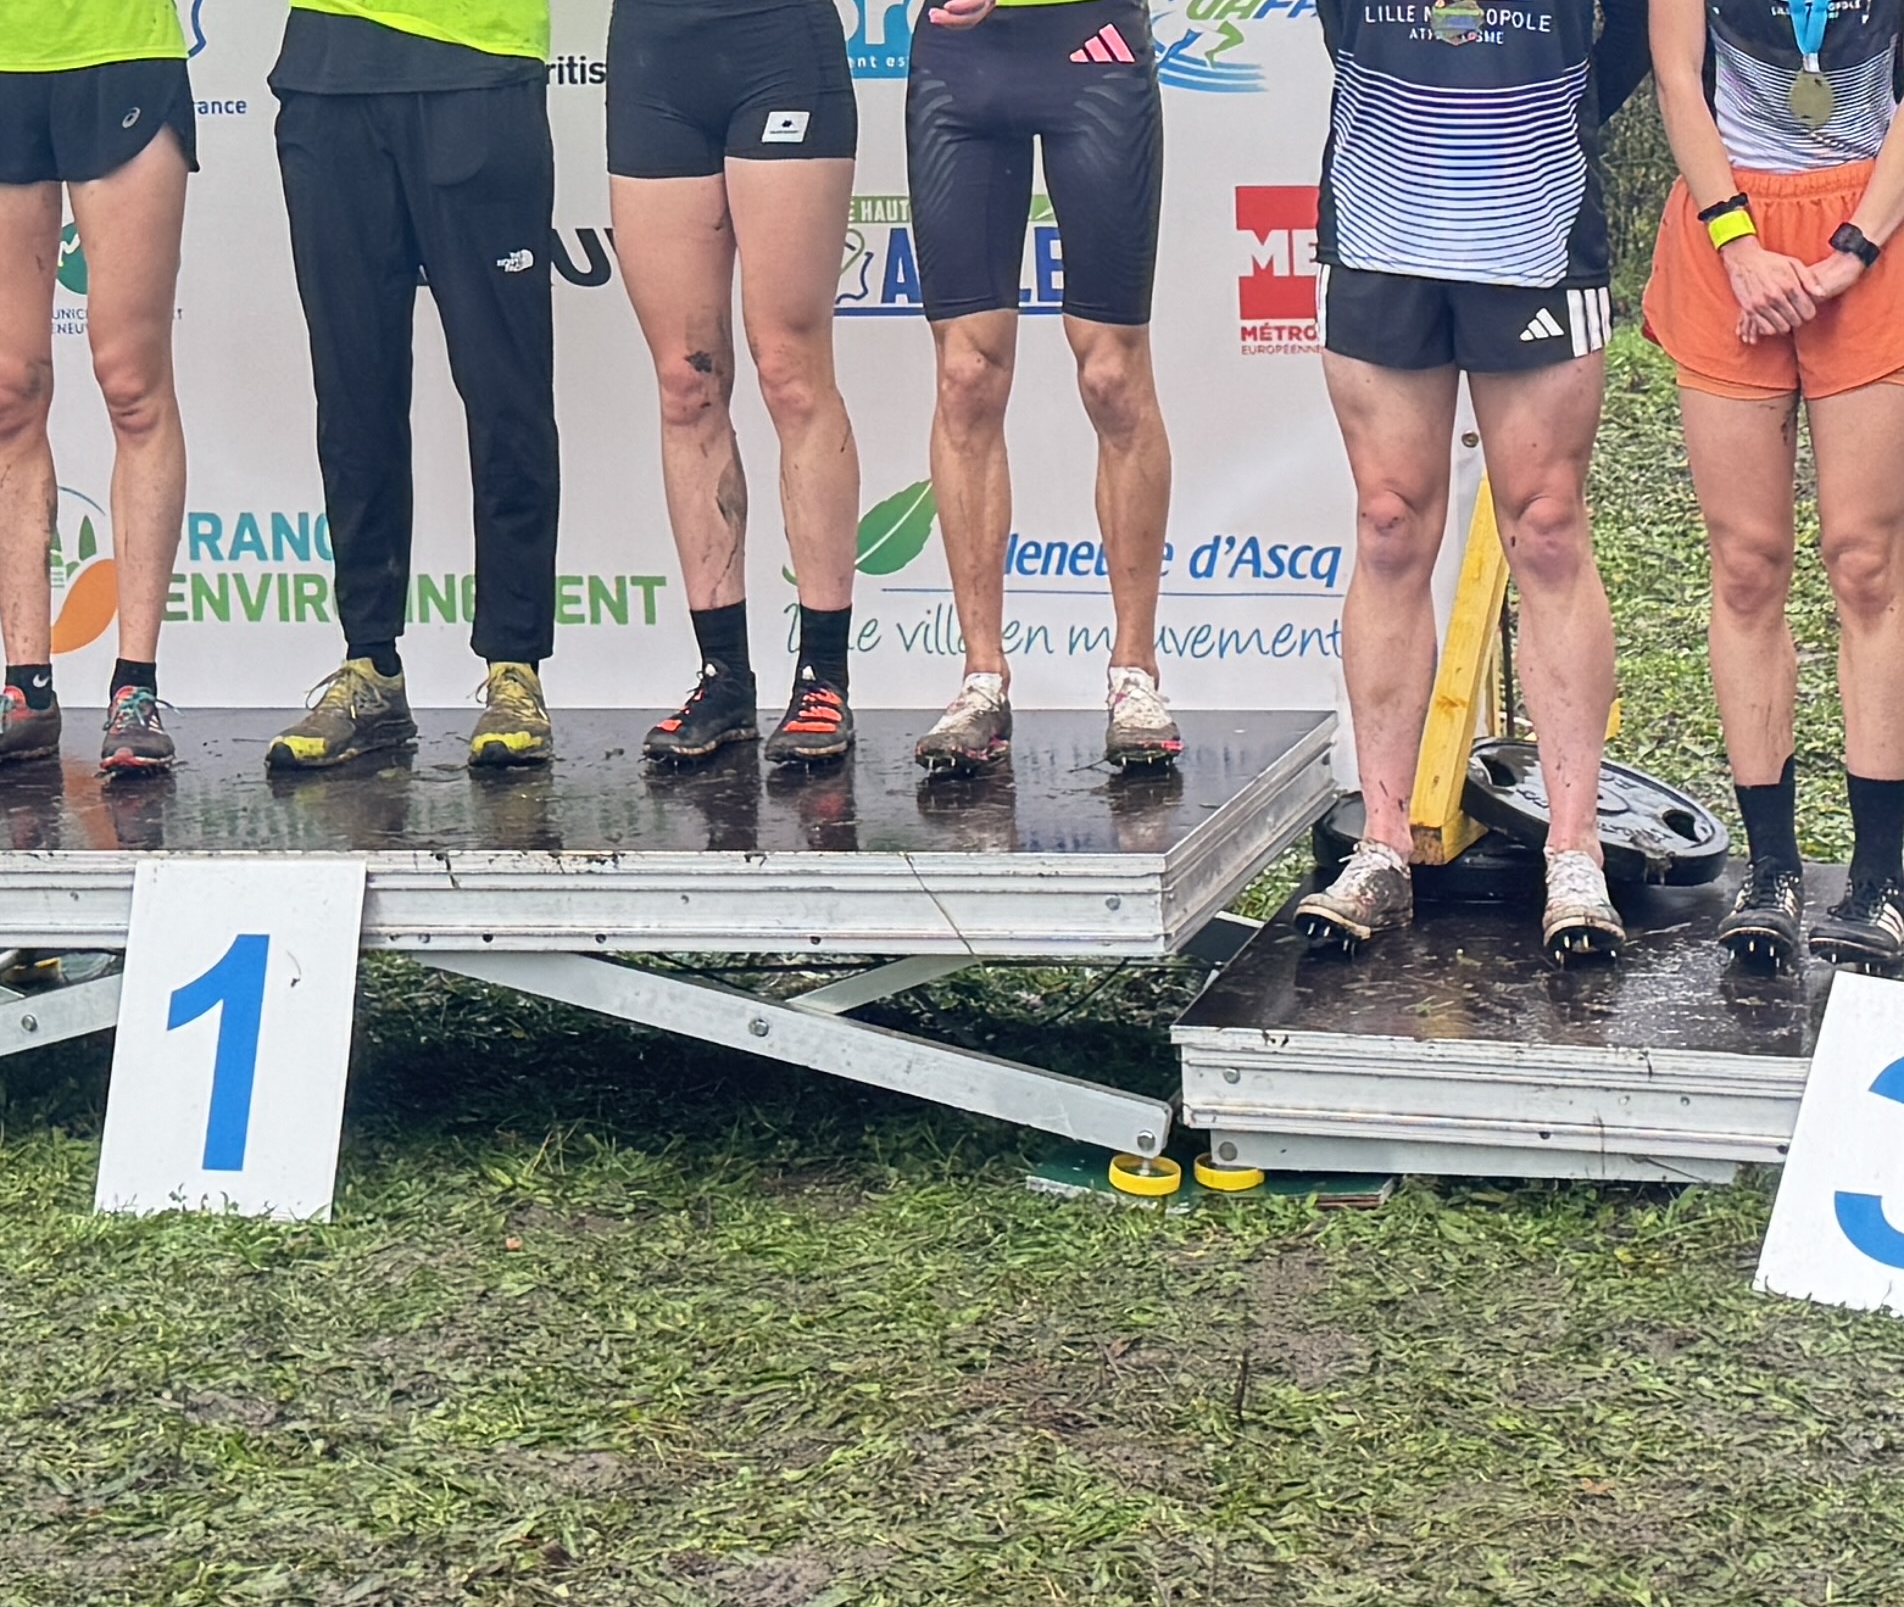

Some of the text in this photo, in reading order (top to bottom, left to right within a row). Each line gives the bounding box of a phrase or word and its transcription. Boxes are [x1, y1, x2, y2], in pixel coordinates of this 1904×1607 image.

[1365, 5, 1552, 33] LILLE OPOLE
[1237, 230, 1318, 277] ME
[1241, 323, 1318, 342] MÉTRO
[1189, 535, 1343, 589] d'Ascq
[896, 602, 967, 657] vill
[1069, 618, 1344, 660] muvement
[167, 933, 271, 1172] 1
